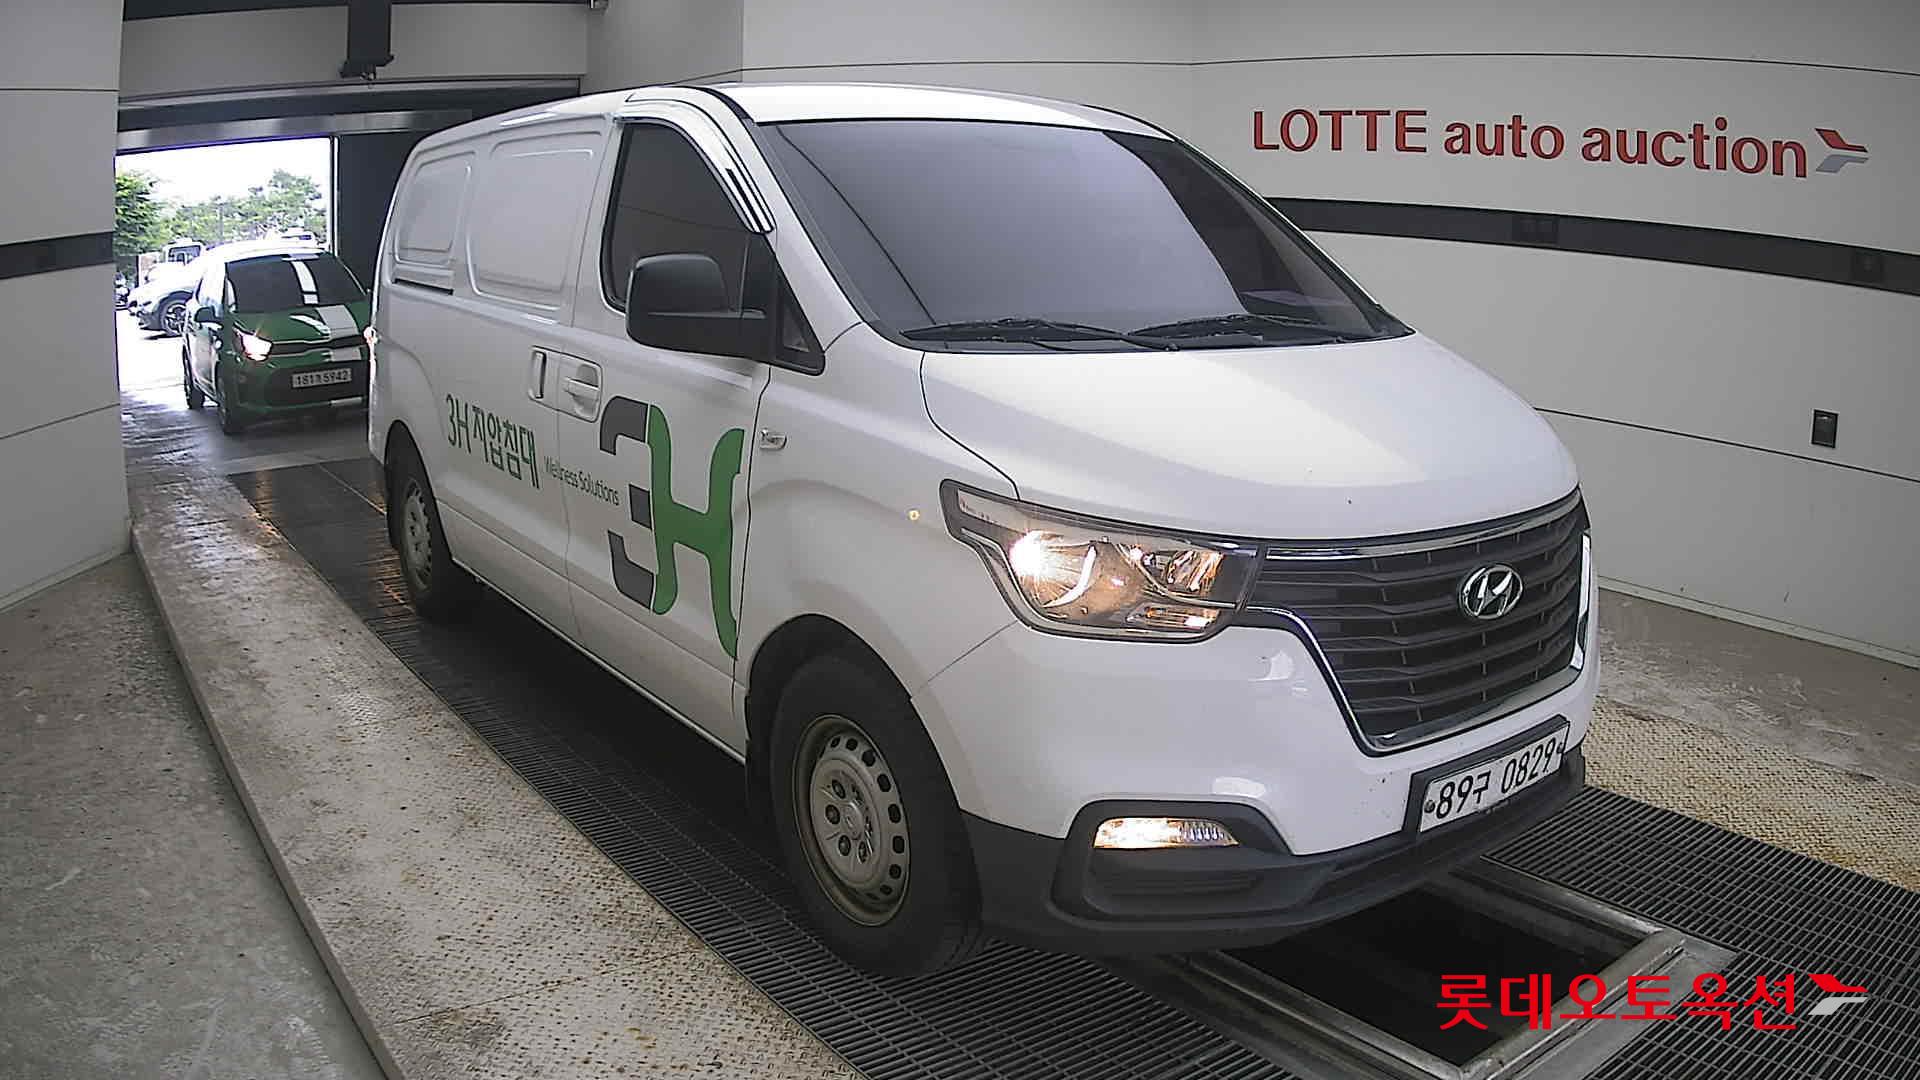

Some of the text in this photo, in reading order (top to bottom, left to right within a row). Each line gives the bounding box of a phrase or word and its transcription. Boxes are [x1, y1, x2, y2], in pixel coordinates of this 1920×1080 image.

[1253, 109, 1808, 179] LOTTE auto auction
[446, 394, 472, 454] 3H
[579, 471, 619, 506] Solutions
[1436, 737, 1556, 819] 89구 0829
